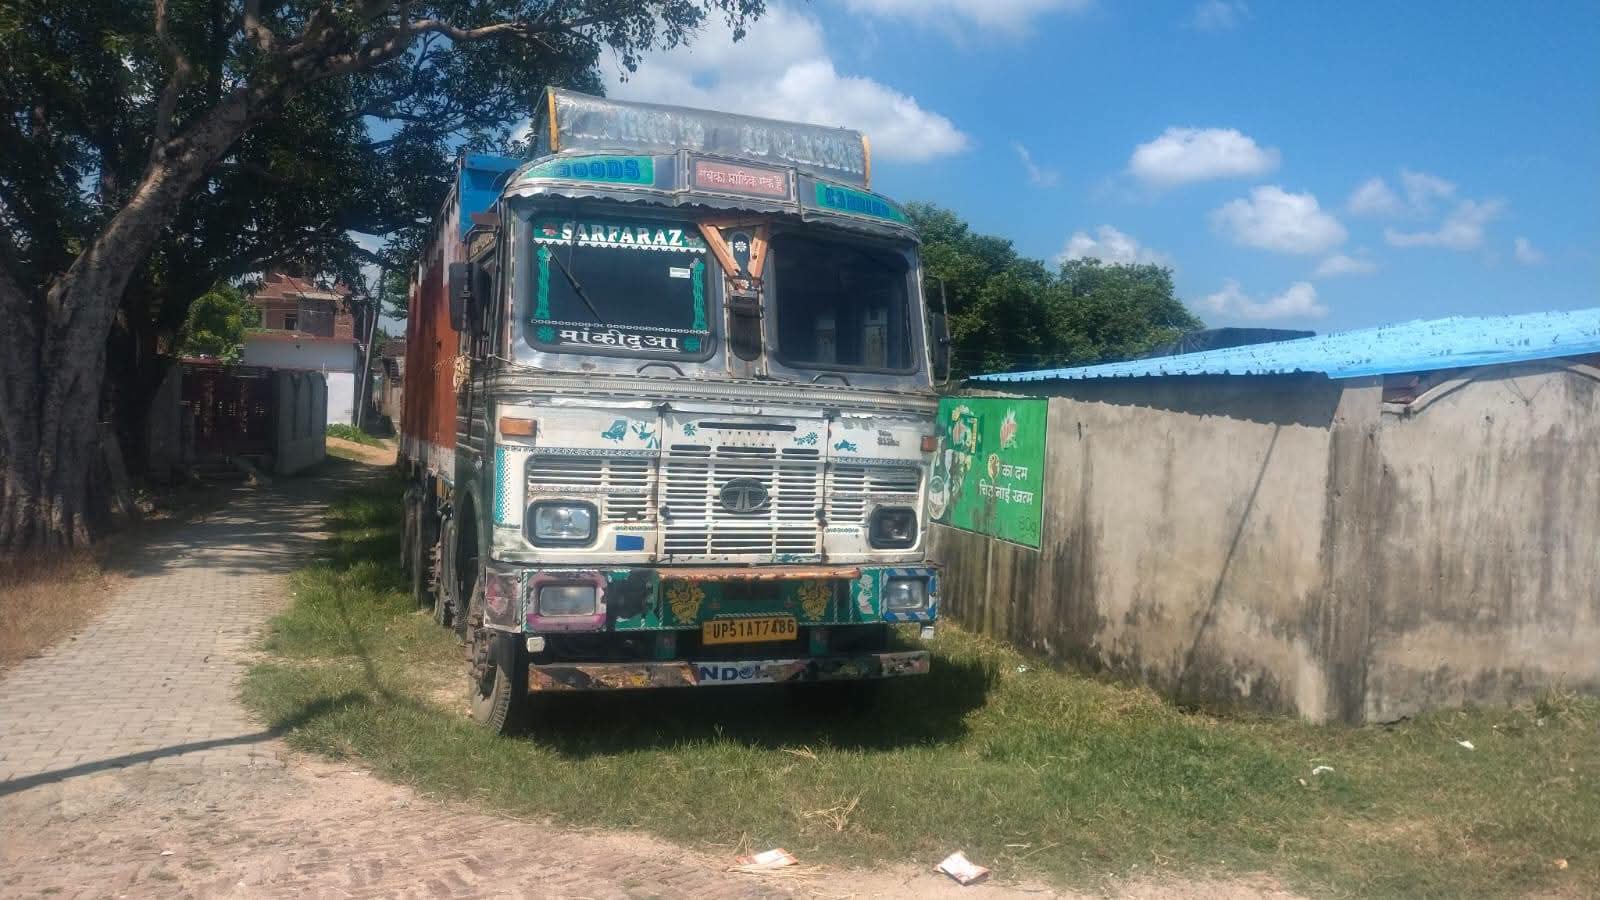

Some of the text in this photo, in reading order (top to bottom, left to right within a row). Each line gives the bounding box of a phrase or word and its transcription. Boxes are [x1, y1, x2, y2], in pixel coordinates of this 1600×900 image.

[561, 222, 683, 247] SARFARAZ
[1002, 464, 1028, 481] का दम
[713, 617, 795, 639] UP51AT7486
